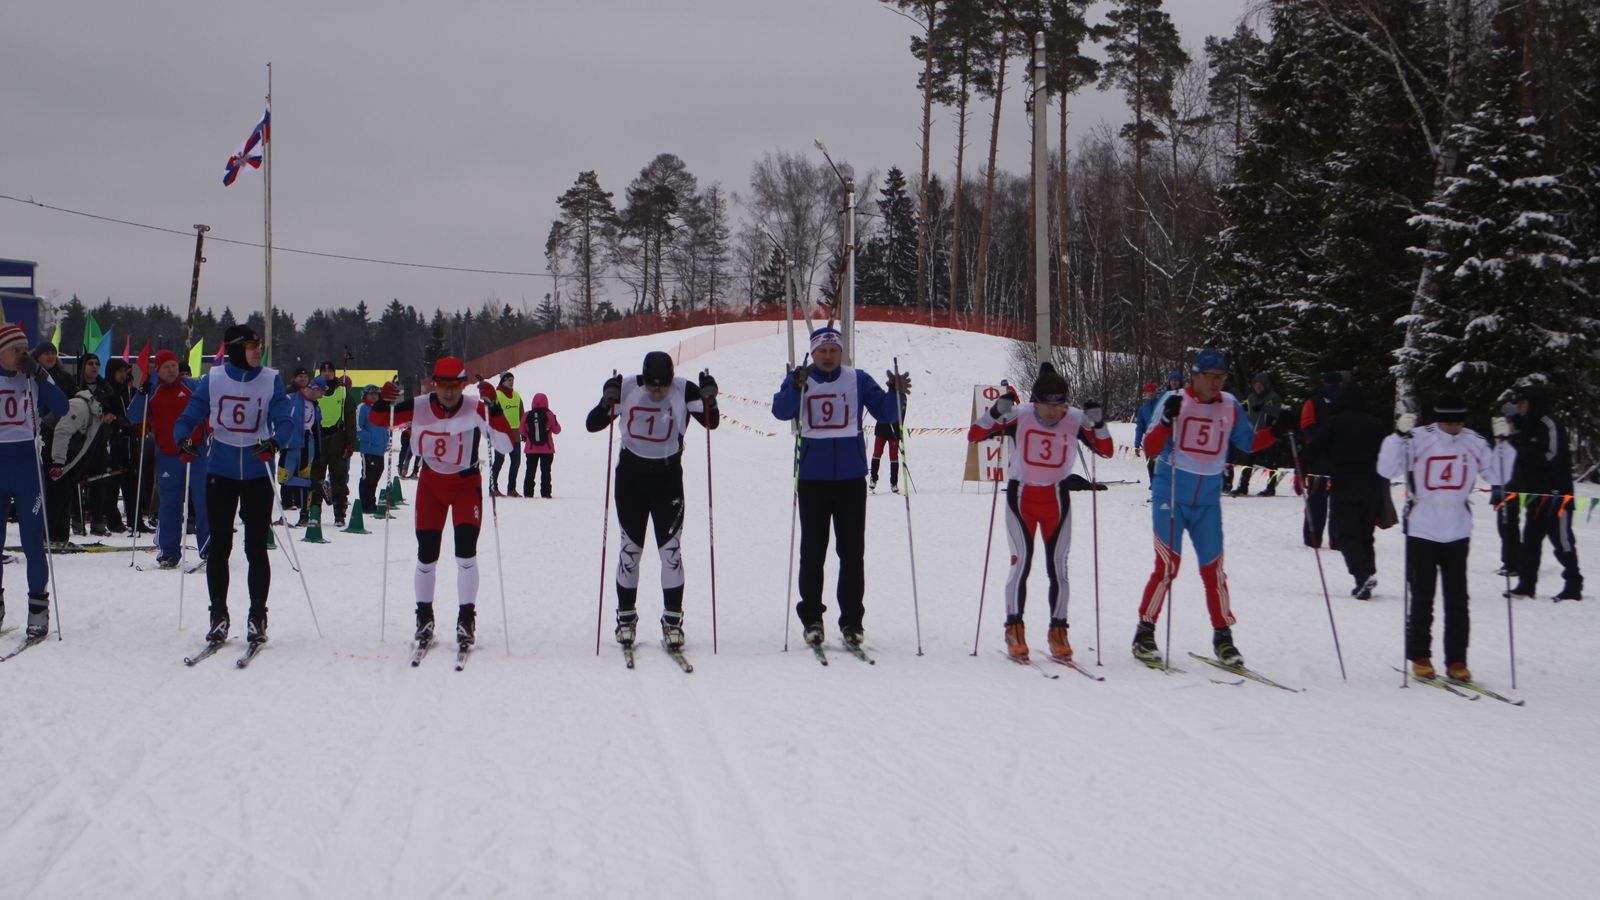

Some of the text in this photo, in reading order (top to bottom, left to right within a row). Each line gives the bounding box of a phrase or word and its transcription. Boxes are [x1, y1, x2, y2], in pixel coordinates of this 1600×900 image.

[233, 403, 246, 425] 6
[822, 401, 833, 422] 9
[645, 415, 655, 435] 1
[1196, 424, 1211, 446] 5
[434, 438, 446, 457] 8
[1039, 439, 1052, 460] 3
[1440, 462, 1453, 482] 4
